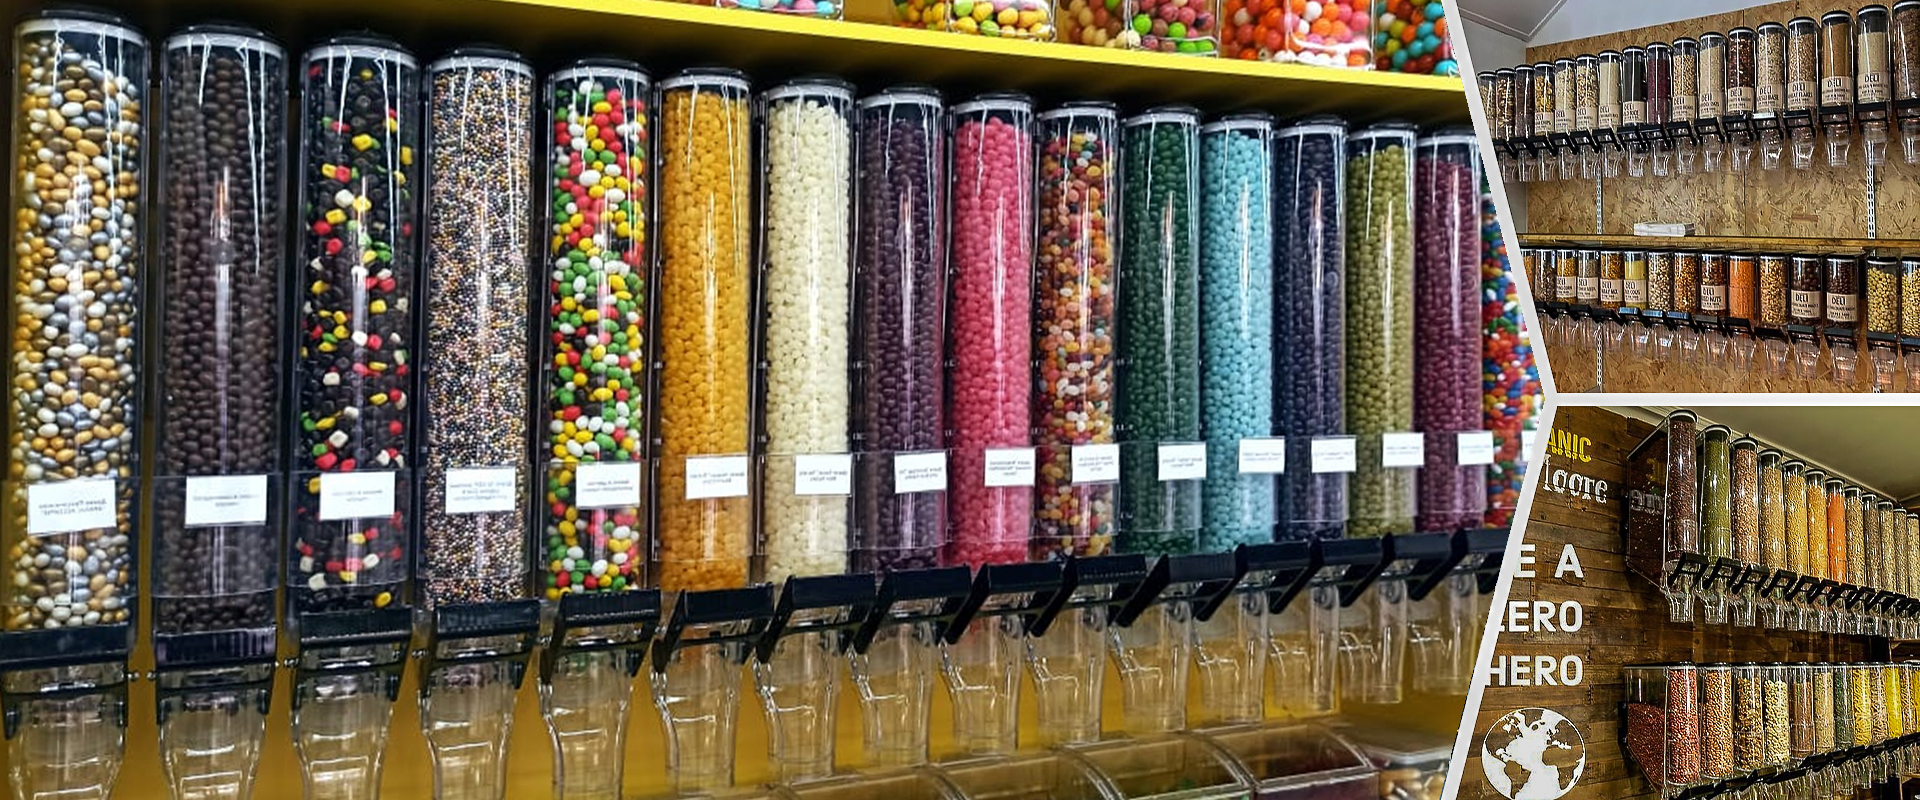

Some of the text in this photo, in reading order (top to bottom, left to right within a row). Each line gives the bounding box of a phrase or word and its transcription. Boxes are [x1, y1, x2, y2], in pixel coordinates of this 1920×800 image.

[1865, 73, 1879, 82] DELI
[1827, 78, 1841, 88] DELI
[1760, 86, 1772, 95] DELI
[1702, 287, 1715, 296] DELI
[1796, 293, 1809, 303] DELI
[1831, 296, 1846, 306] DELI
[1554, 543, 1584, 578] A
[1499, 600, 1583, 633] ERO
[1485, 655, 1584, 687] HERO
